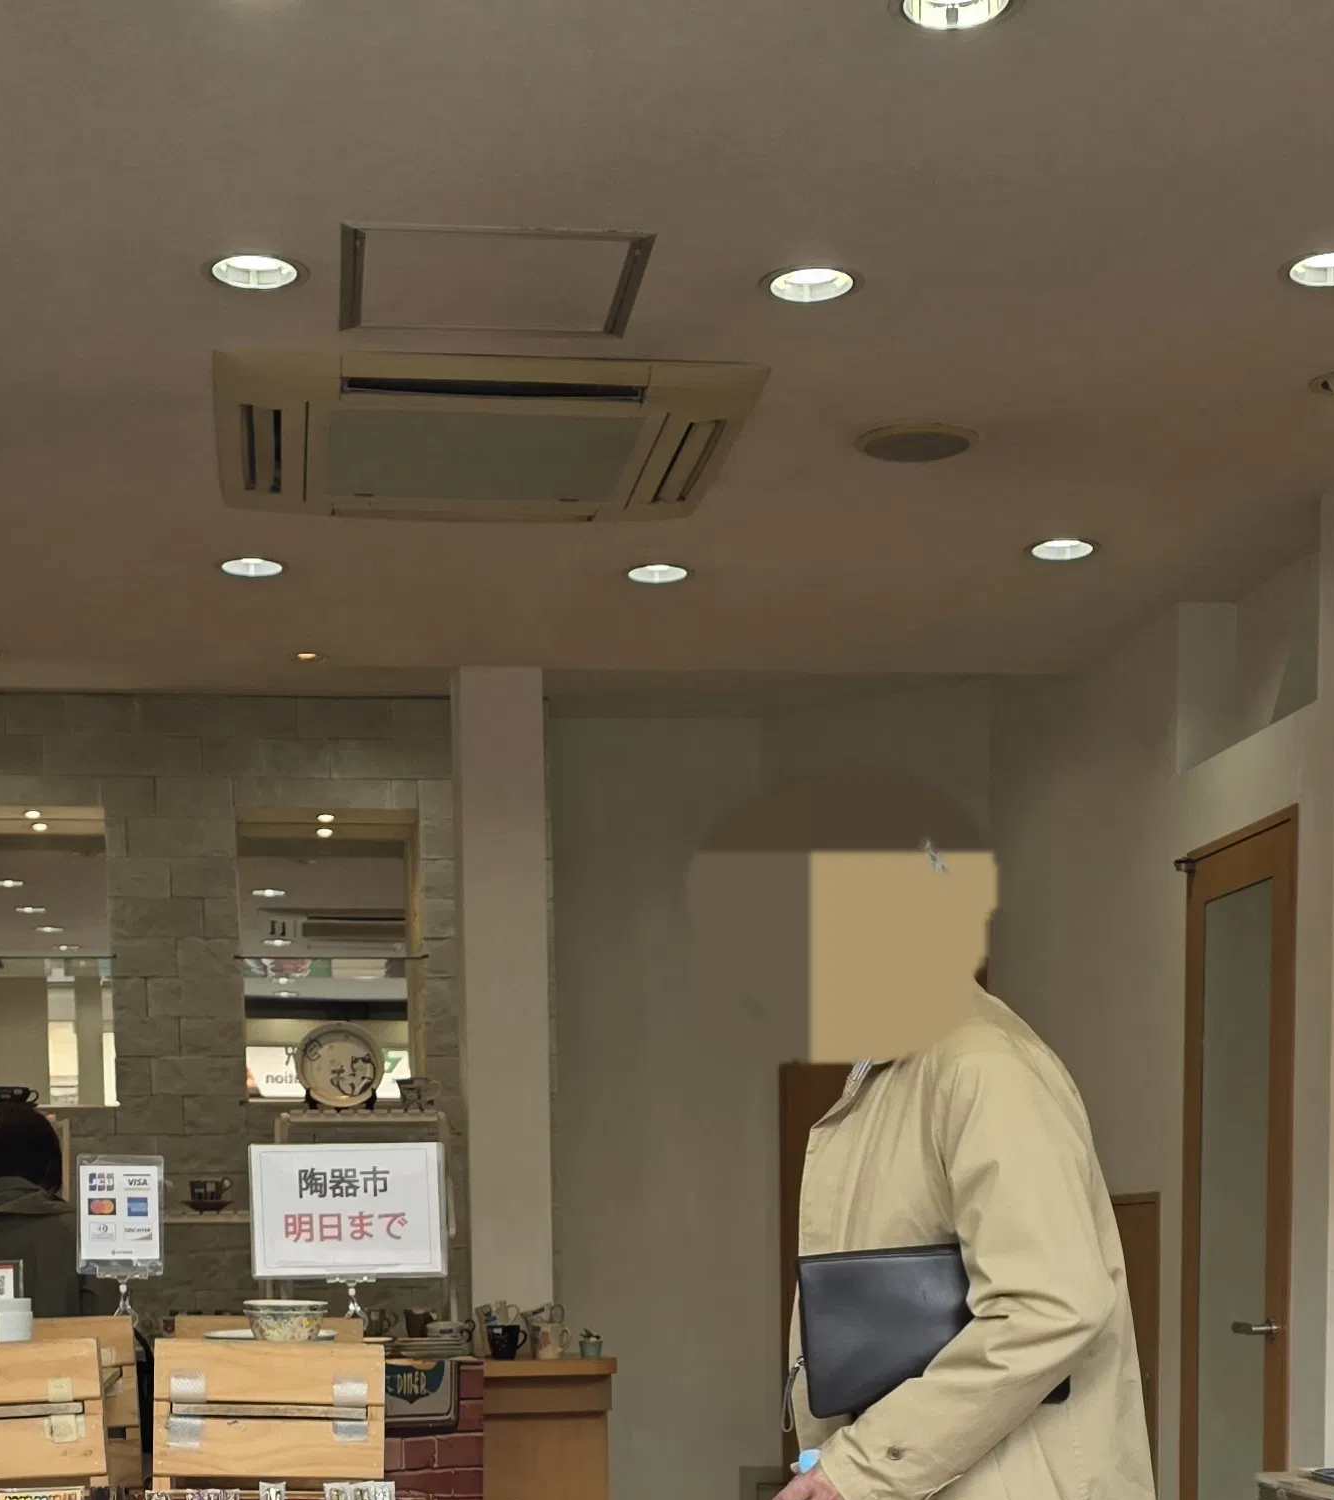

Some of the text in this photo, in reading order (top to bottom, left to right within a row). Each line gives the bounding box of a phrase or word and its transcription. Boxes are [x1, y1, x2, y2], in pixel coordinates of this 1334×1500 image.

[297, 1166, 390, 1198] 陶器市
[284, 1211, 408, 1243] 明日まで
